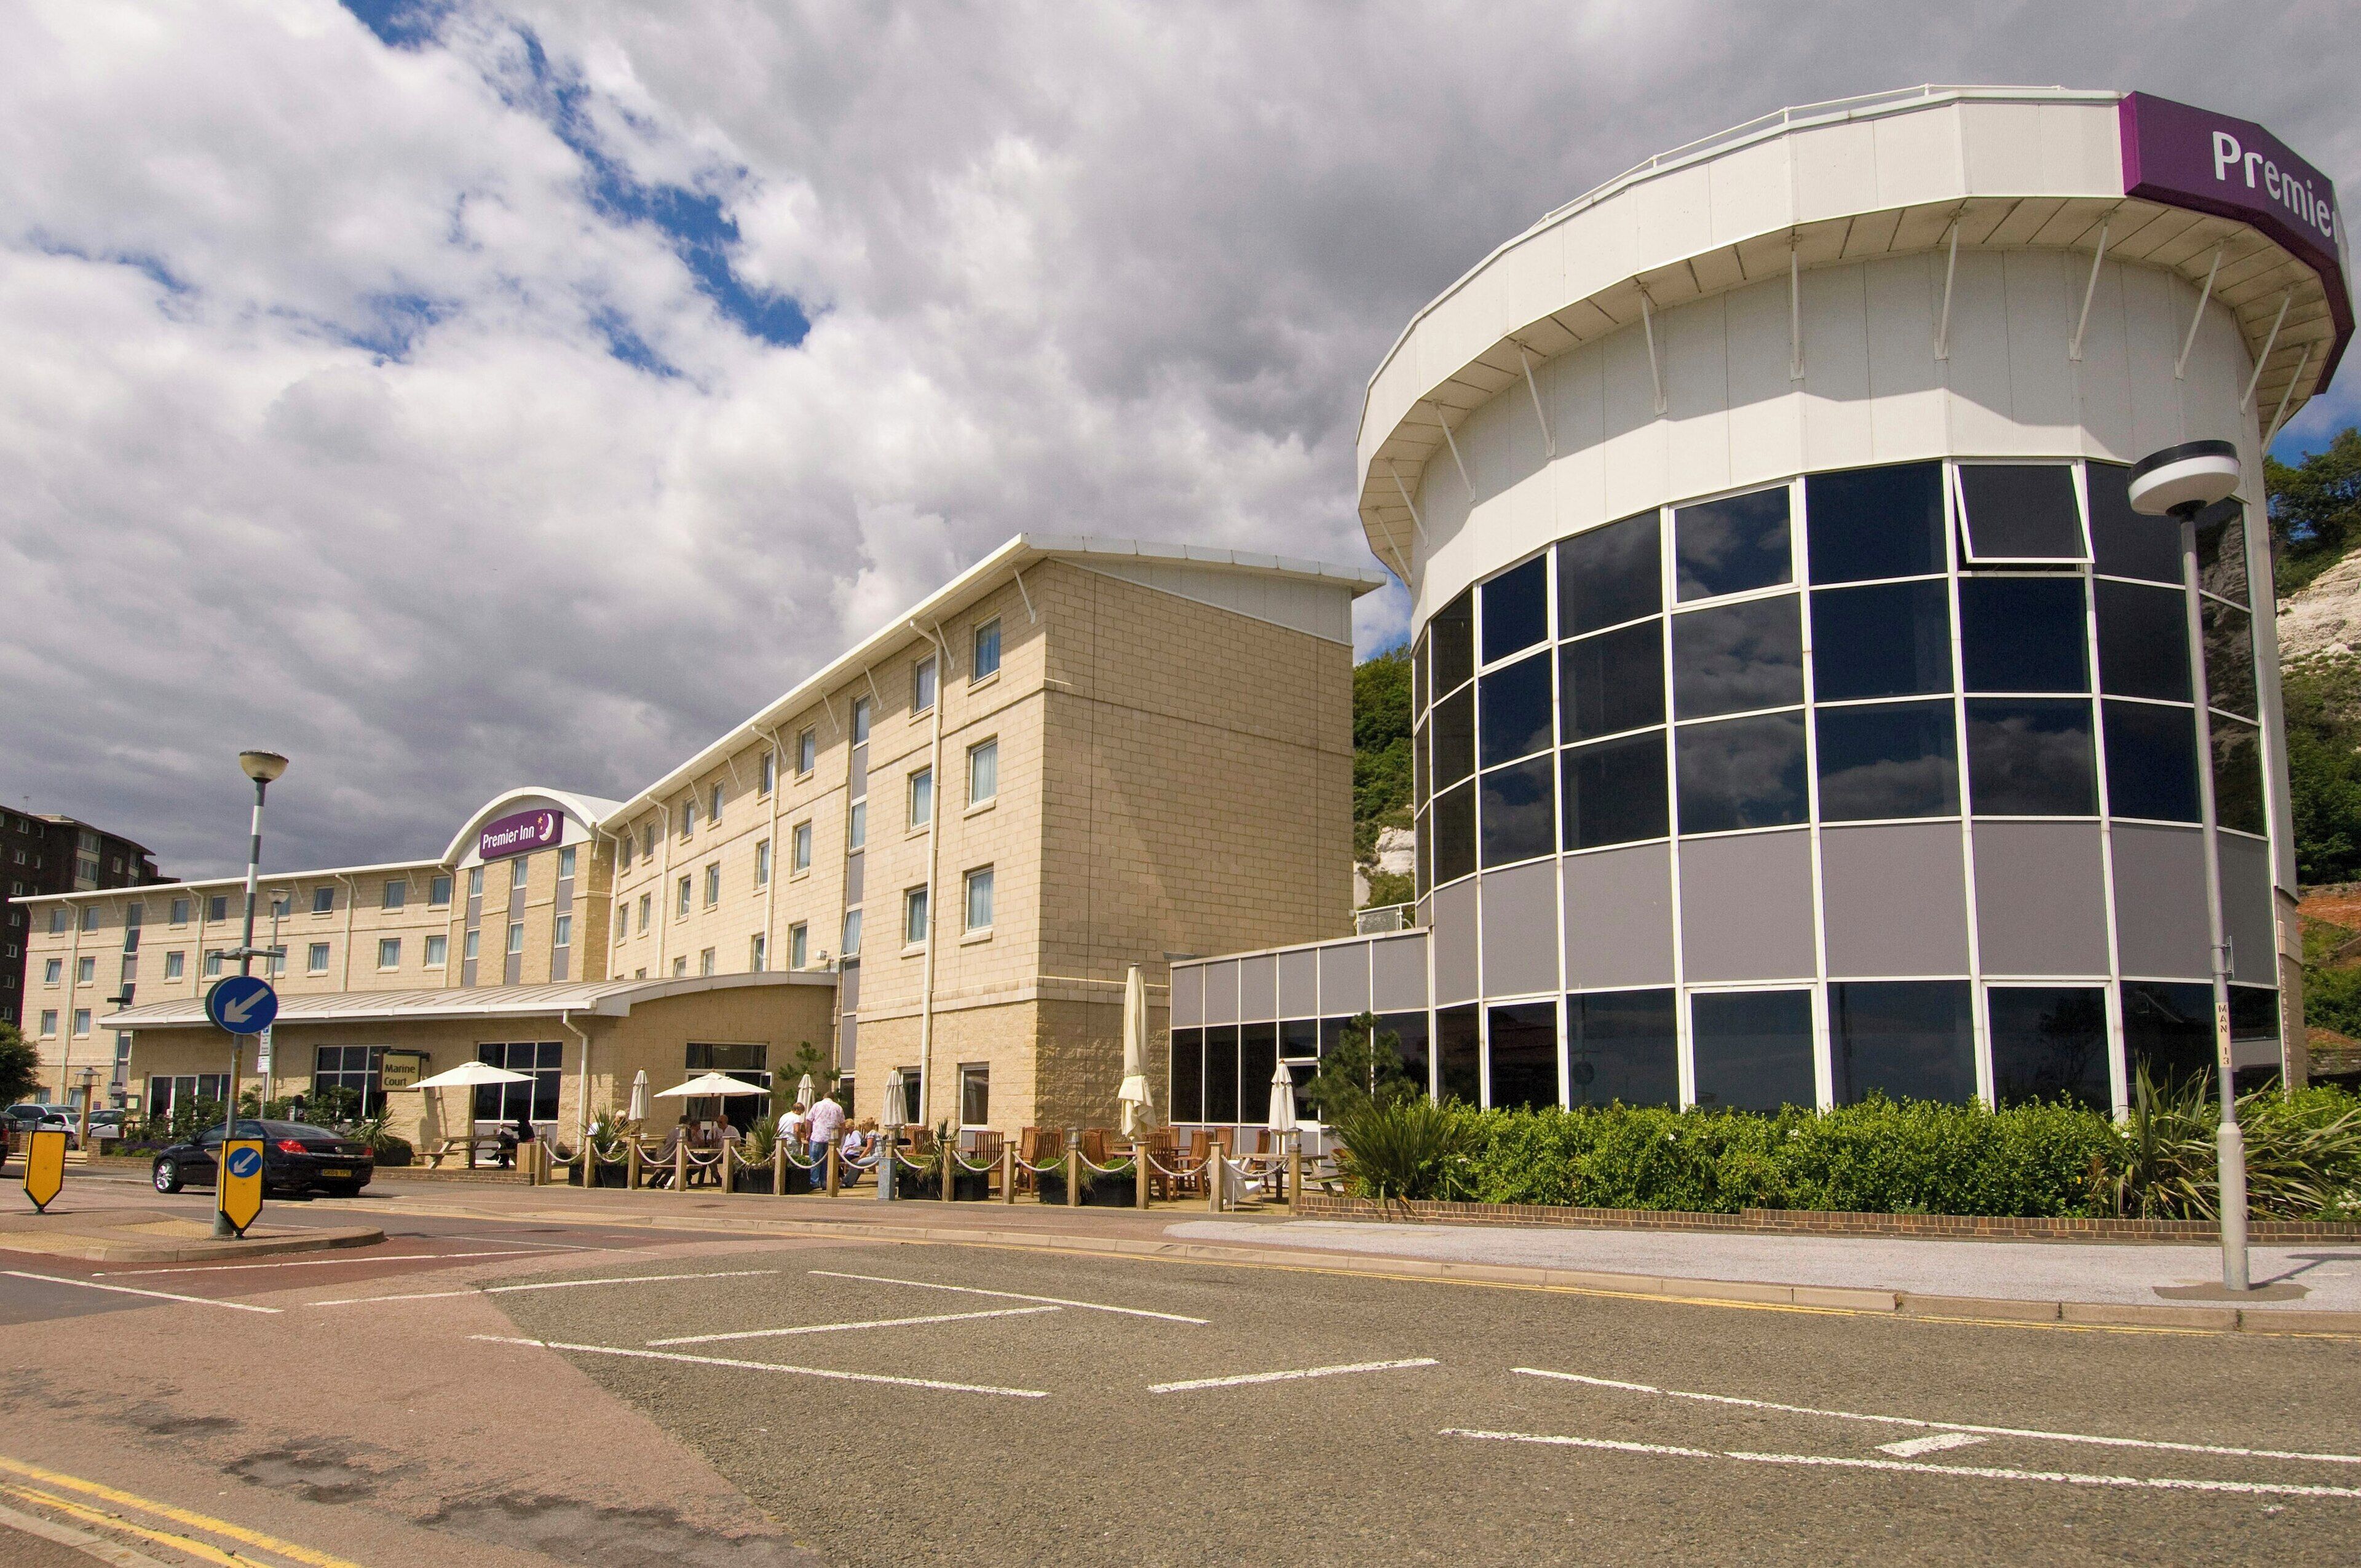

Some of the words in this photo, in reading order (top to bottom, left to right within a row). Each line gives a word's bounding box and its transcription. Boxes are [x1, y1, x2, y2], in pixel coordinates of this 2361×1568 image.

[483, 828, 518, 849] Premier
[520, 825, 535, 840] Inn
[2218, 1005, 2228, 1033] MAN
[384, 1064, 416, 1073] Marine
[384, 1077, 407, 1086] Court
